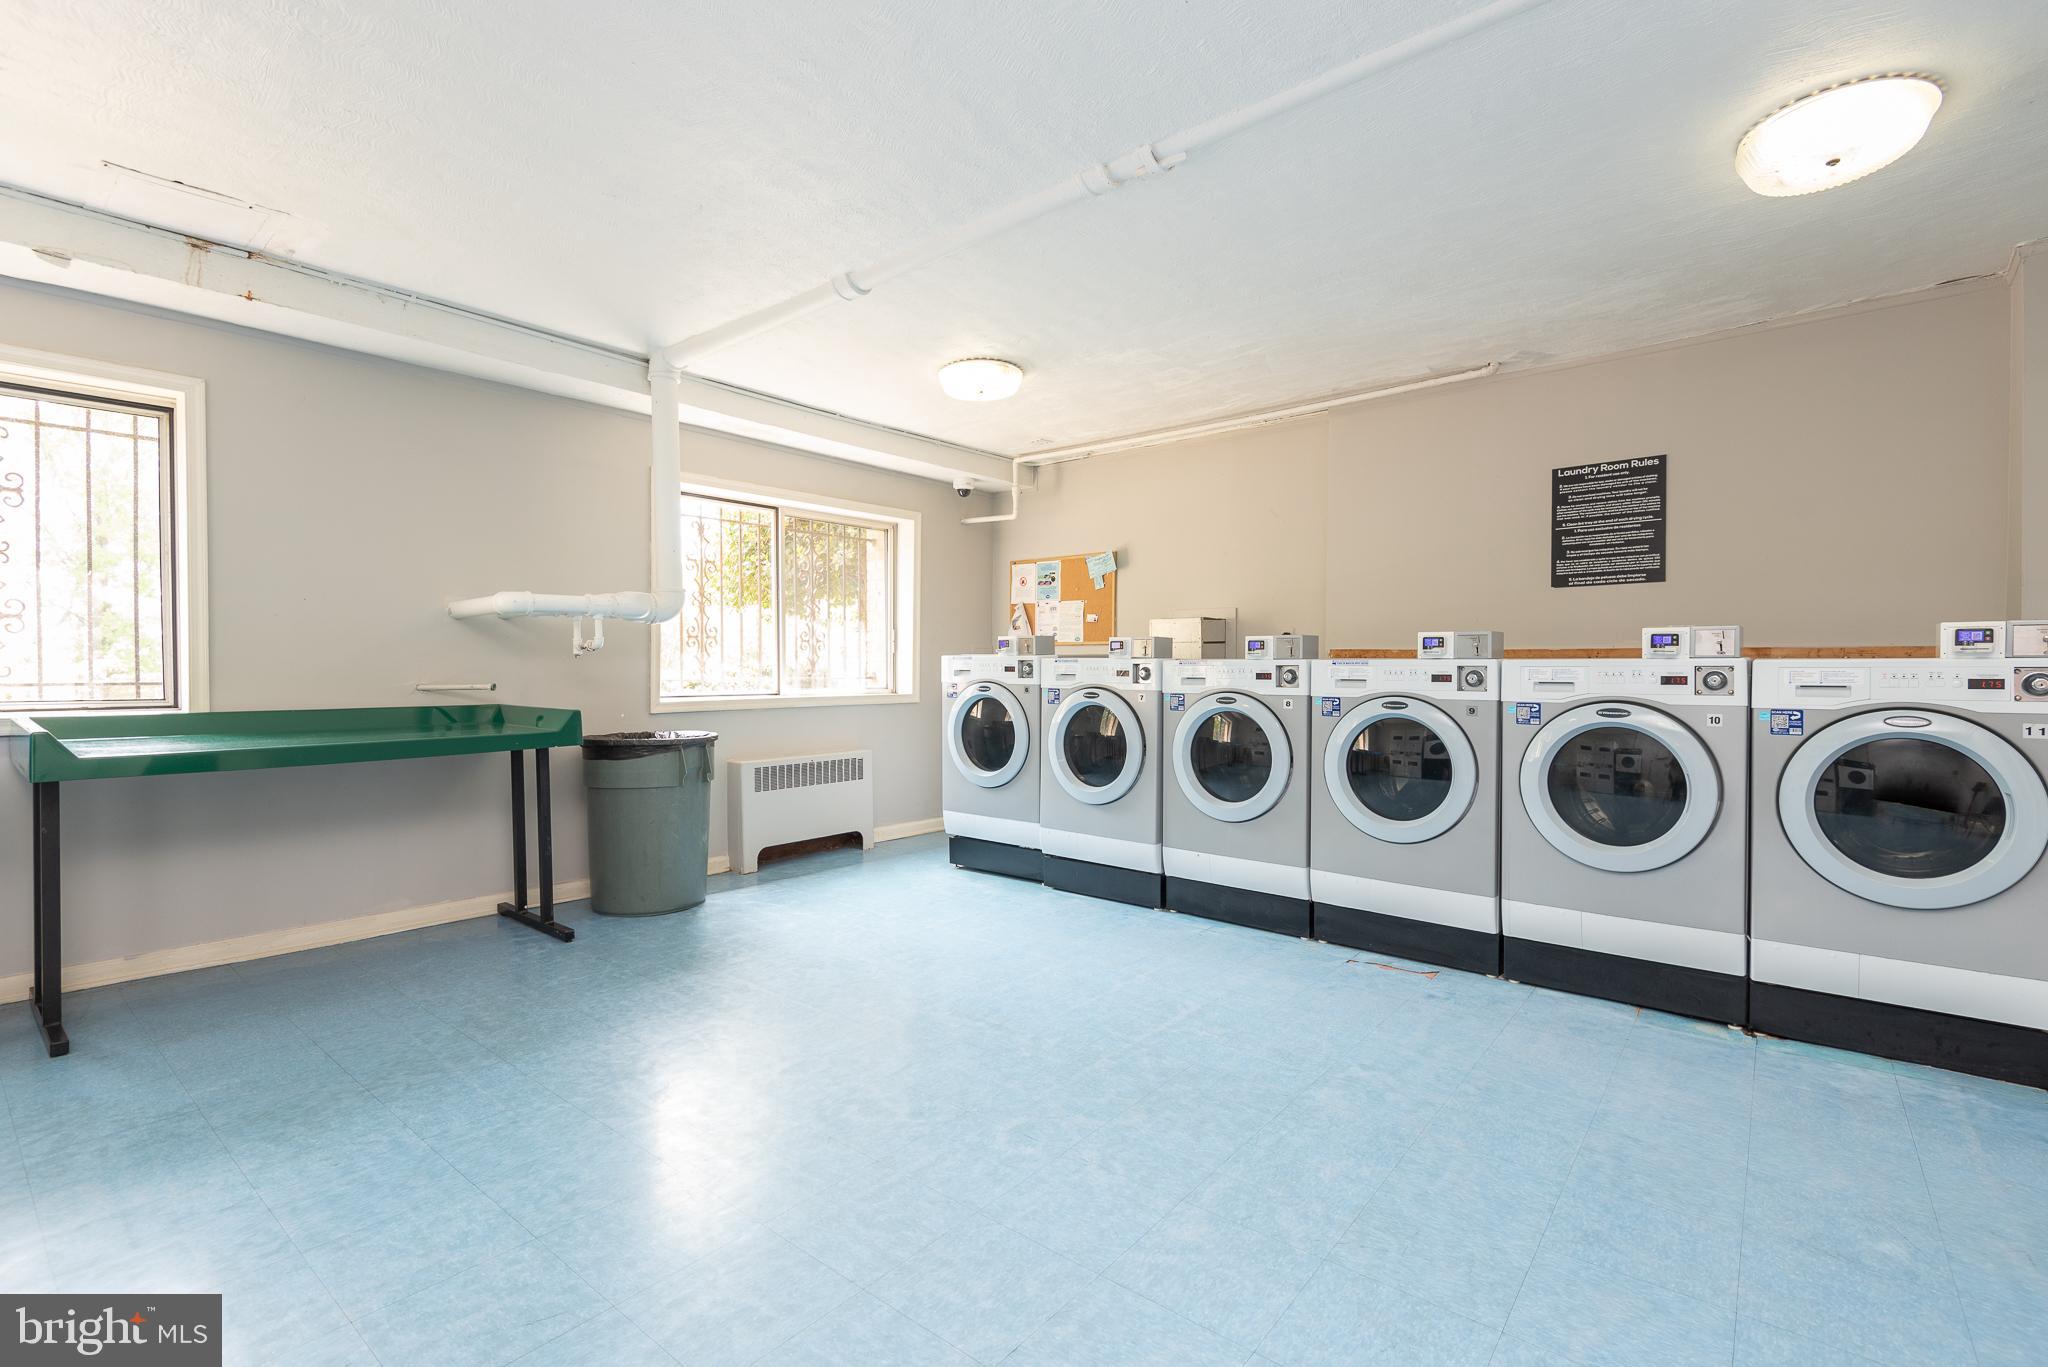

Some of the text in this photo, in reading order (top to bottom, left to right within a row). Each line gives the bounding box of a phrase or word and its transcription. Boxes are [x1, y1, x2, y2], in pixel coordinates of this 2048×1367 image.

[1558, 458, 1660, 477] Laundry Room Rules
[1468, 707, 1475, 715] 9
[1709, 717, 1721, 725] 10
